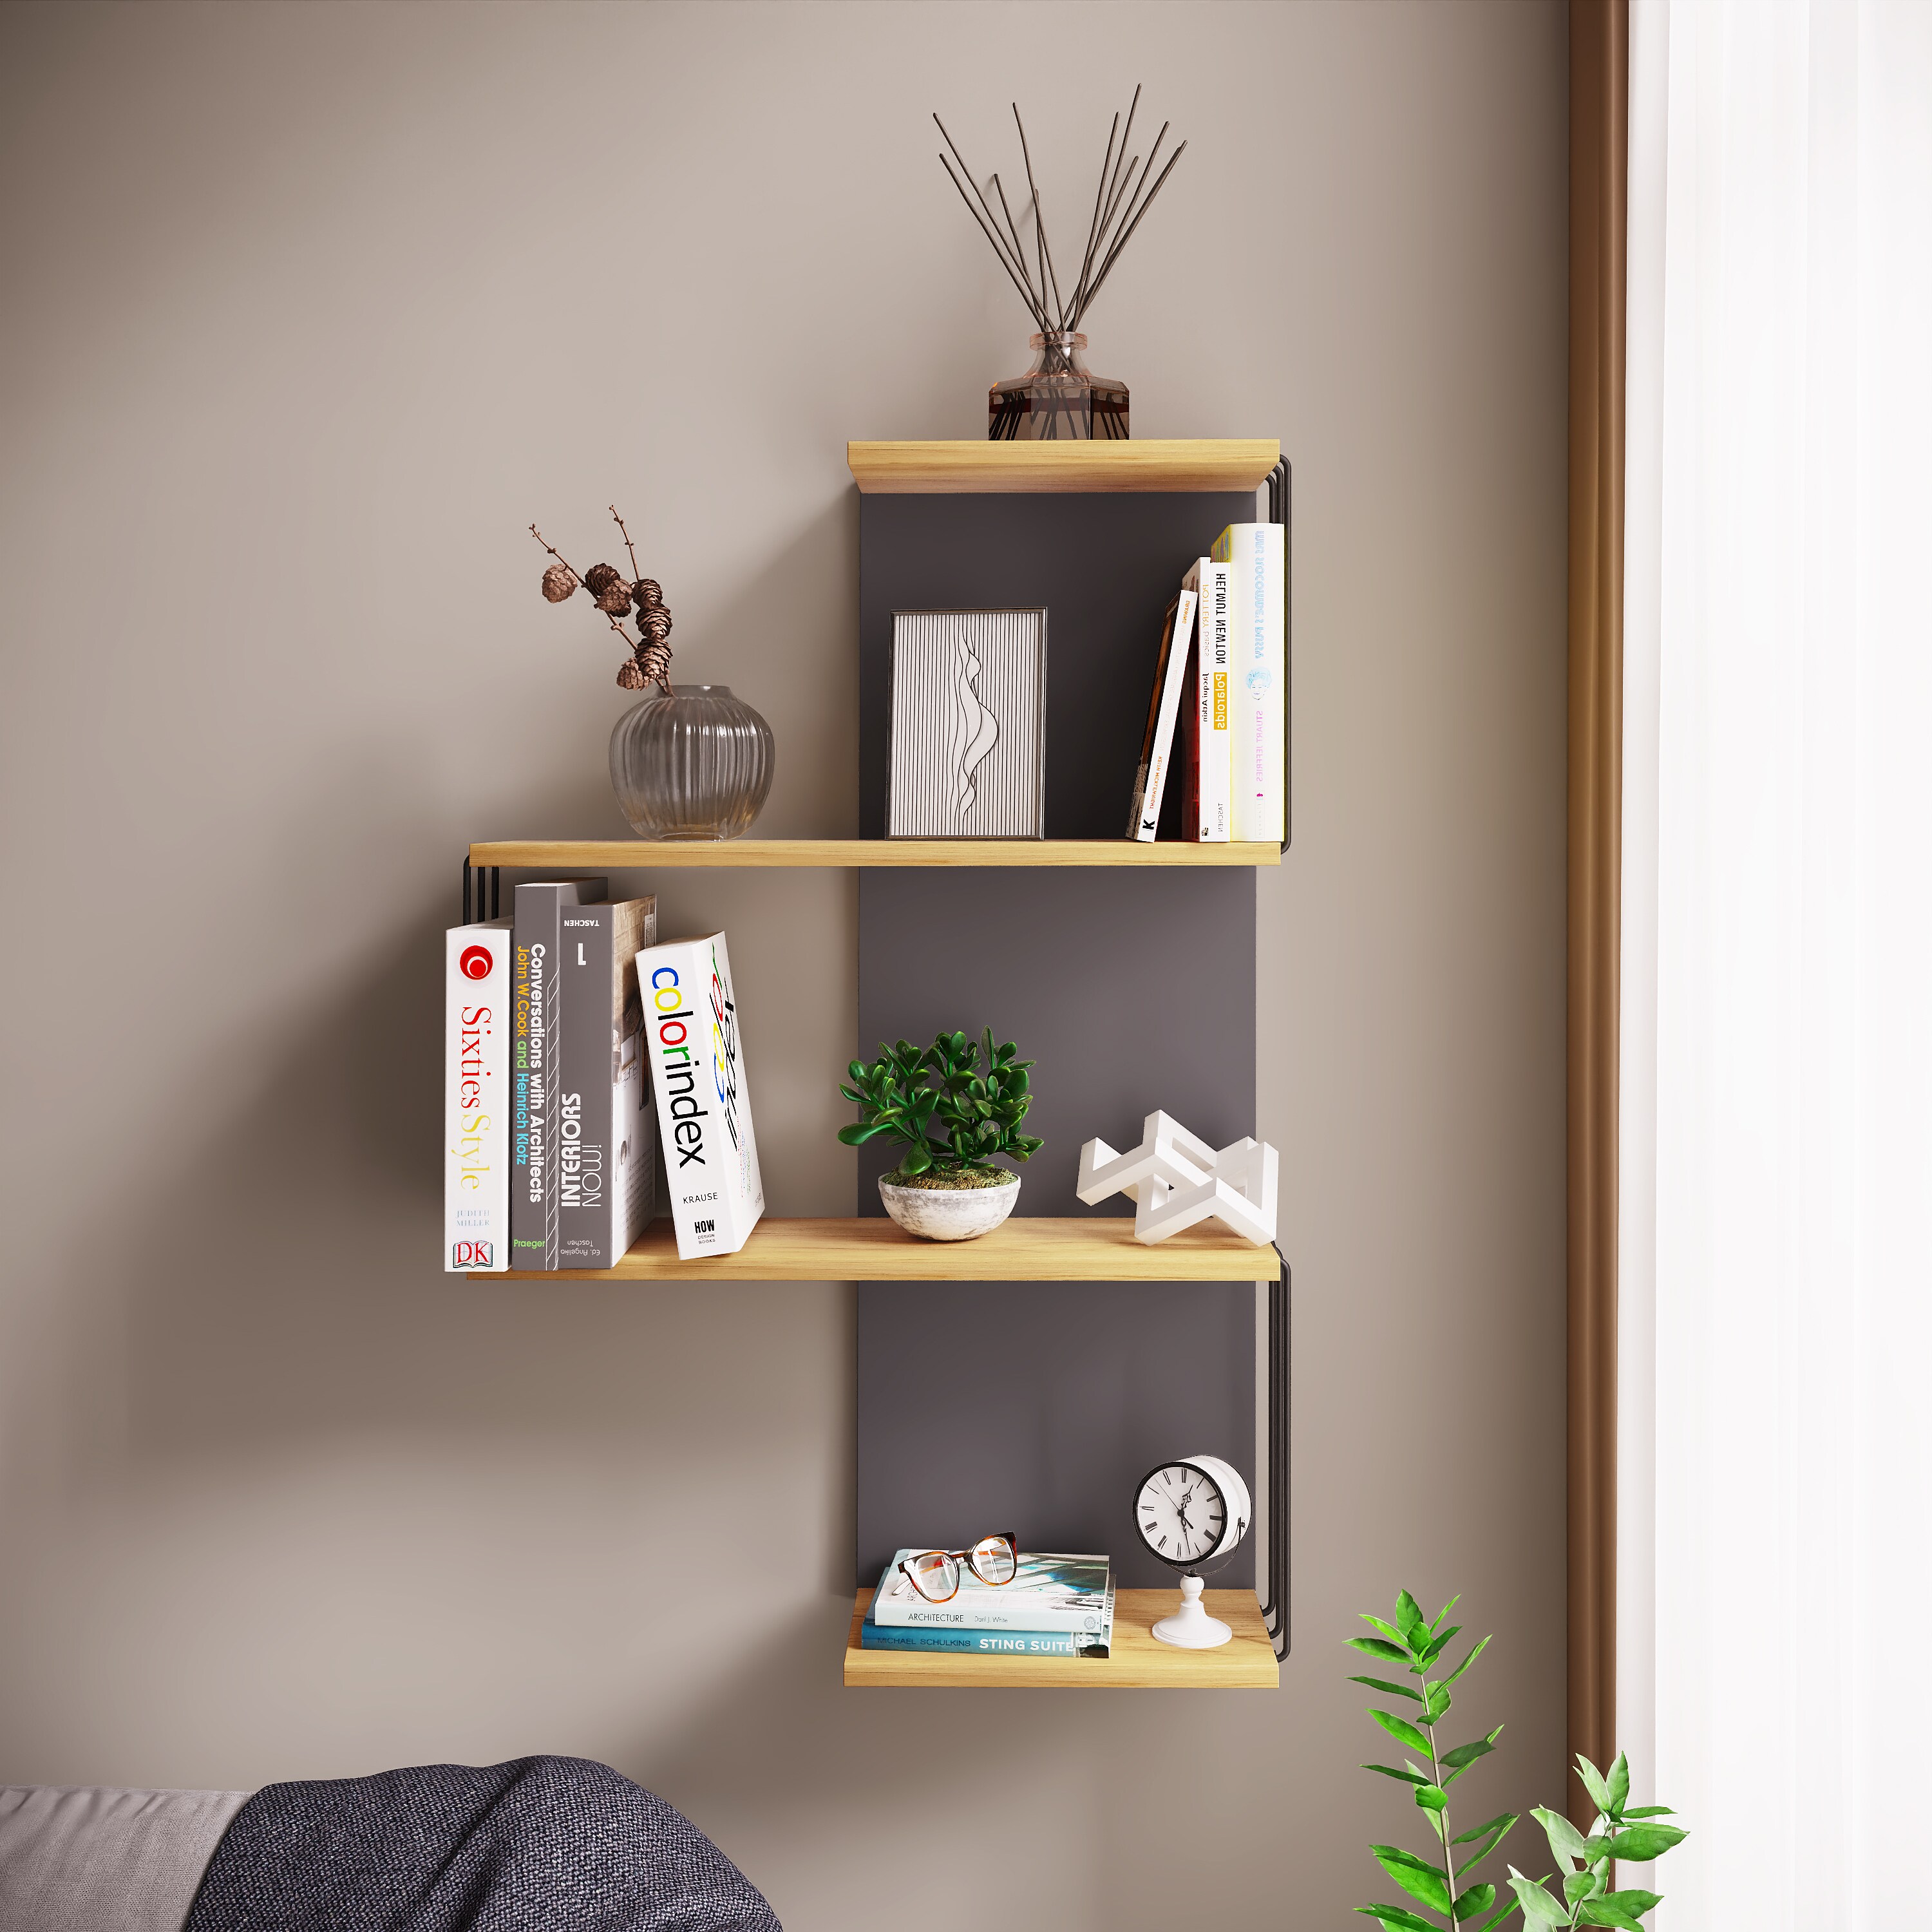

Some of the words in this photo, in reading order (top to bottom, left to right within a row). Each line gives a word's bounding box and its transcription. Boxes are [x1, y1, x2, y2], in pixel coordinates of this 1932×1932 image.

[518, 946, 529, 979] John
[578, 943, 586, 965] 1
[531, 943, 545, 1068] Conversations
[461, 1007, 491, 1108] Sixties
[517, 1041, 529, 1068] and
[652, 967, 708, 1168] colorindex
[516, 1074, 529, 1129] Heinrich
[530, 1074, 545, 1110] with
[451, 1115, 491, 1189] Style
[516, 1133, 529, 1165] Klotz
[529, 1115, 544, 1203] Architects
[561, 1093, 581, 1207] INTERIORS
[582, 1144, 601, 1207] NOW!
[455, 1209, 489, 1218] JUDITH
[683, 1193, 718, 1204] KRAUSE
[694, 1219, 715, 1233] HOW
[457, 1242, 489, 1264] DK
[513, 1239, 545, 1249] Praeger
[560, 1247, 588, 1256] Angelika
[908, 1613, 964, 1622] ARCHITECTURE
[979, 1639, 1025, 1651] STING
[1030, 1640, 1074, 1653] SUITE
